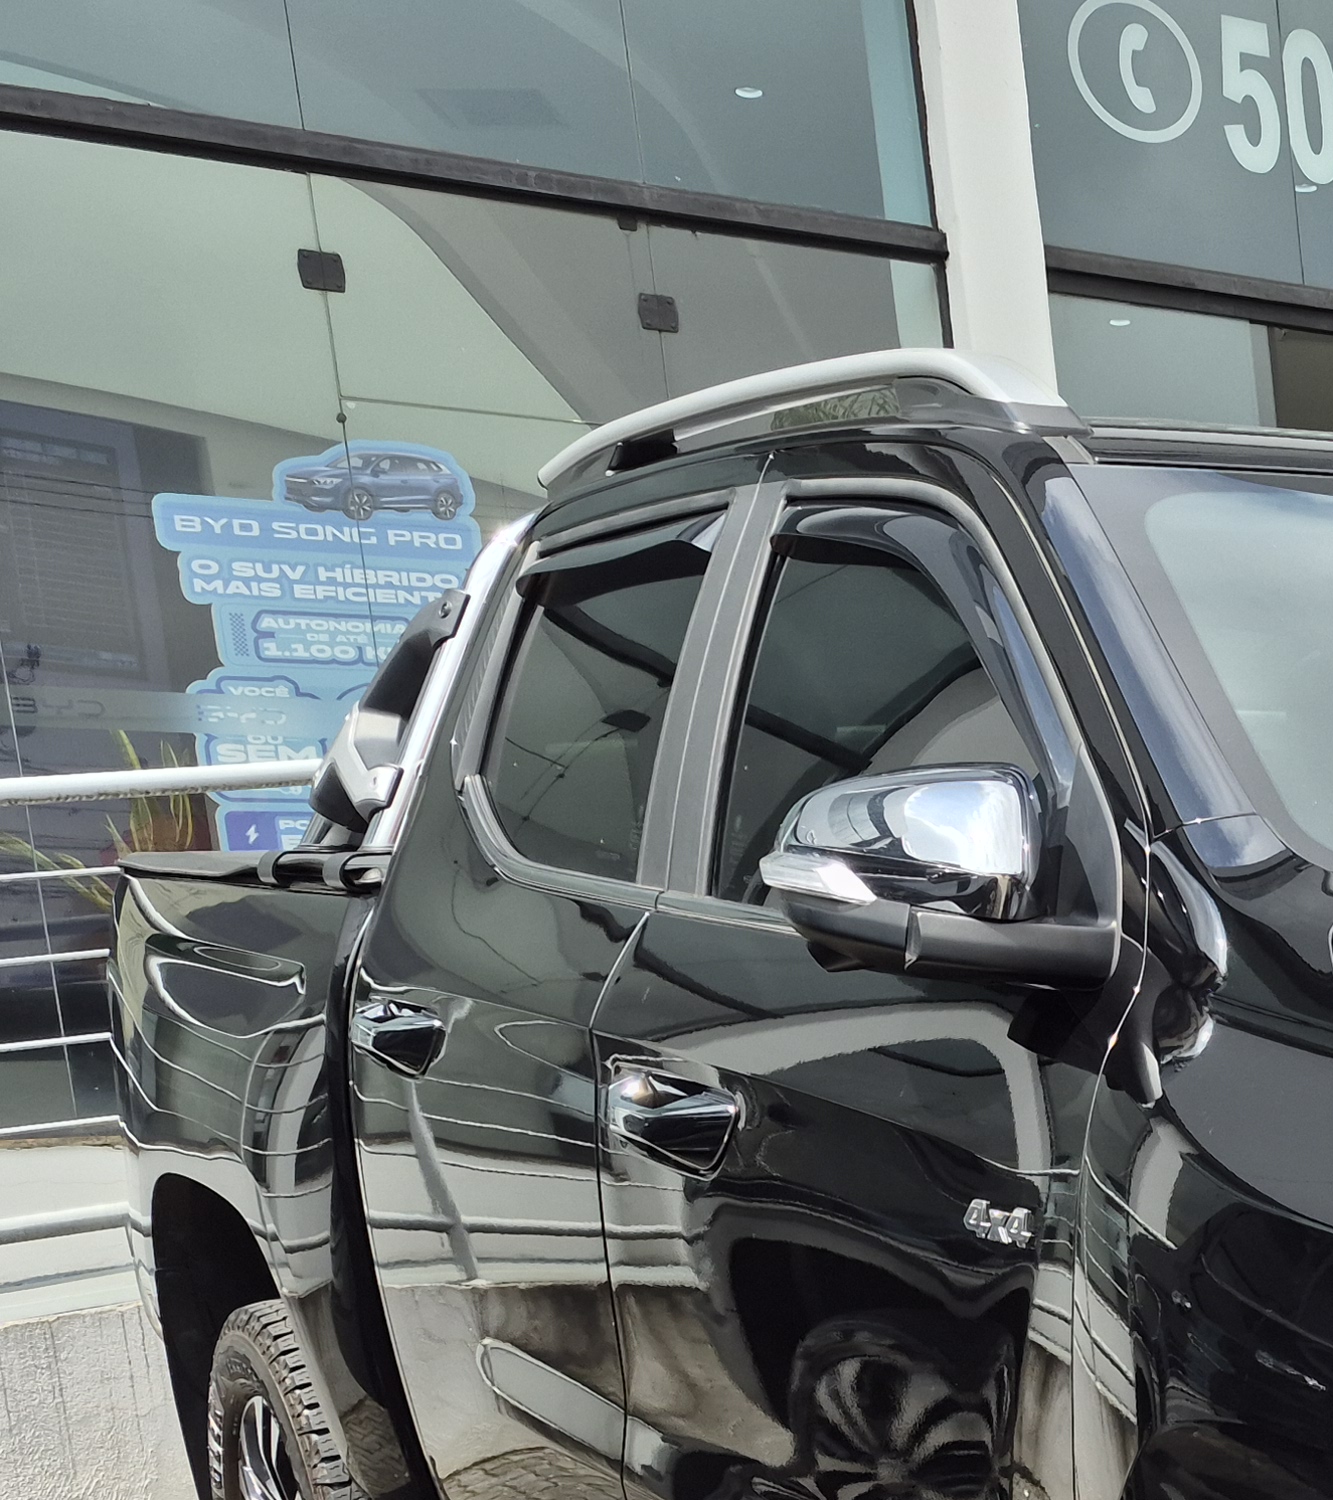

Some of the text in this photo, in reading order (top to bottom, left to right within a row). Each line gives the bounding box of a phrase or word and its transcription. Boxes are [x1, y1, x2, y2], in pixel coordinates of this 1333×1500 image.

[173, 514, 463, 550] BYD SONG PRO
[191, 559, 459, 589] O SUV HÍBRIDO
[193, 578, 442, 605] MAIS EFICIENT
[259, 616, 406, 634] AUTONOMIA
[263, 642, 357, 659] 1.100
[228, 685, 291, 698] VOCÊ
[216, 743, 317, 763] SEM
